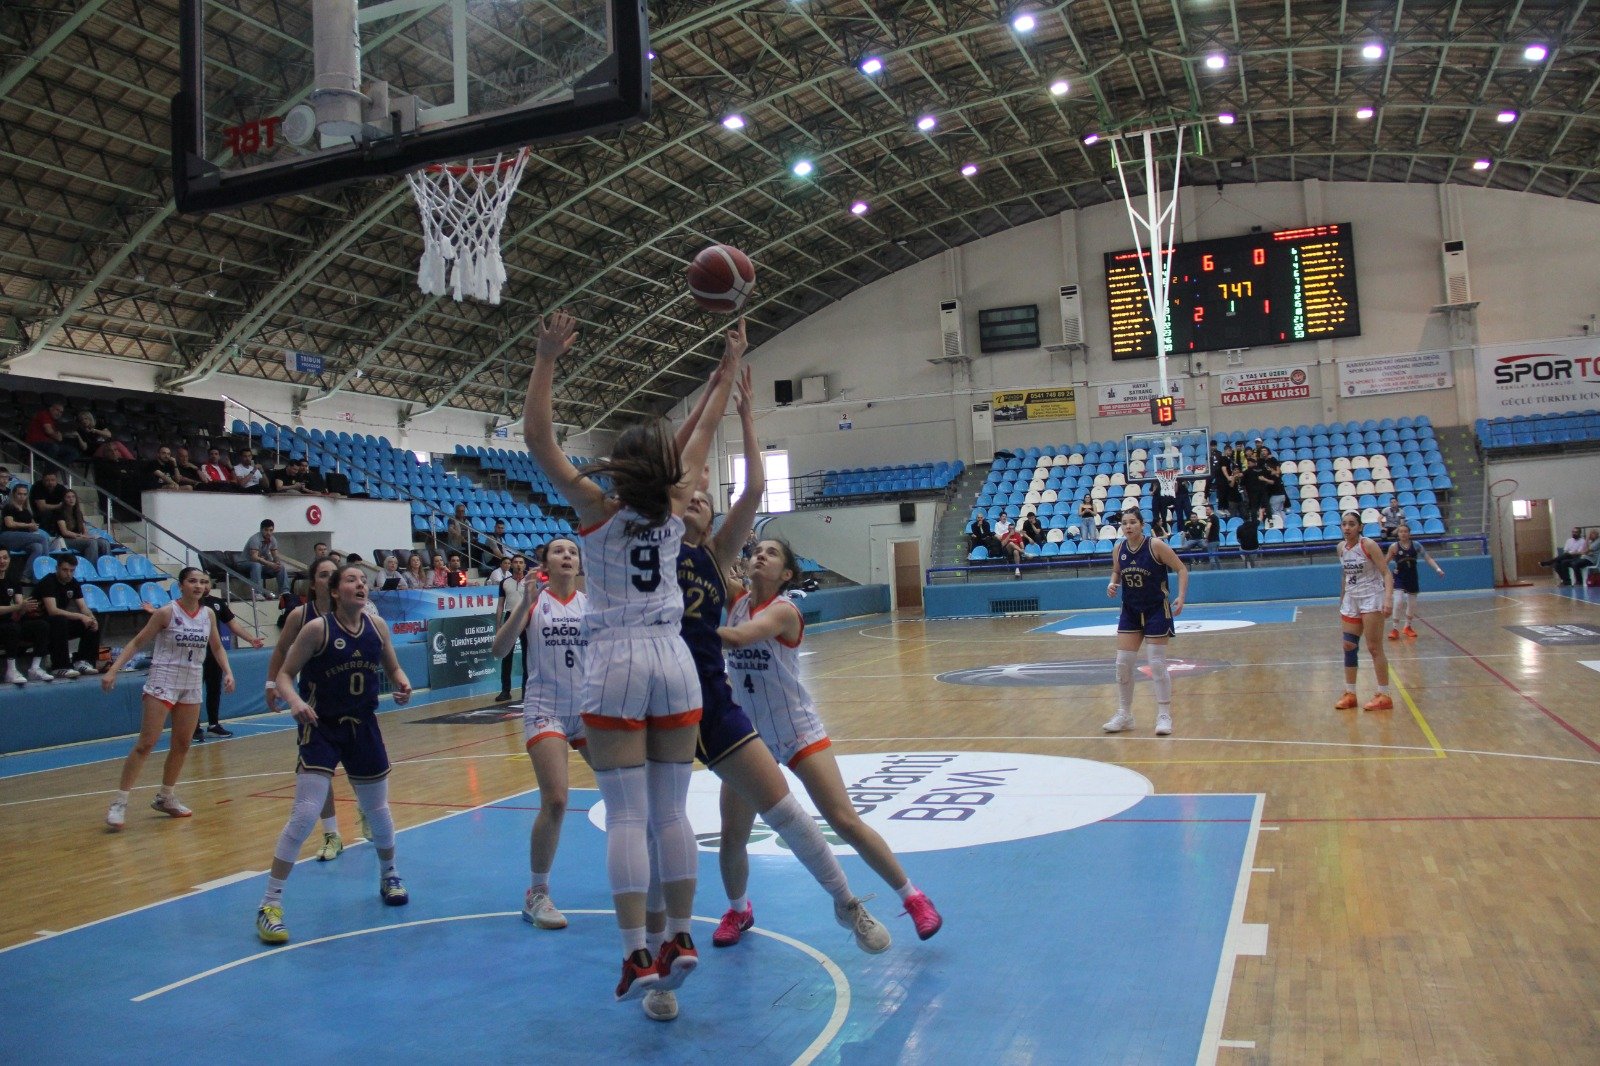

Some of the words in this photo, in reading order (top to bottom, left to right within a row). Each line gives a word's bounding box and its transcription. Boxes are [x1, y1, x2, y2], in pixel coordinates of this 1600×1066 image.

[1203, 254, 1214, 271] 6
[1253, 248, 1265, 265] 0
[1193, 306, 1204, 322] 2
[1263, 299, 1270, 314] 1
[1223, 391, 1268, 403] KARATE
[1272, 387, 1307, 398] KURSU
[1158, 407, 1172, 422] 13
[630, 545, 661, 592] 9
[1125, 573, 1143, 588] 53
[437, 593, 494, 611] EDİRNE
[450, 636, 473, 647] TÜRKİYE
[564, 649, 575, 668] 6
[349, 672, 365, 696] 0
[743, 673, 755, 694] 4
[886, 767, 1019, 822] BBVA
